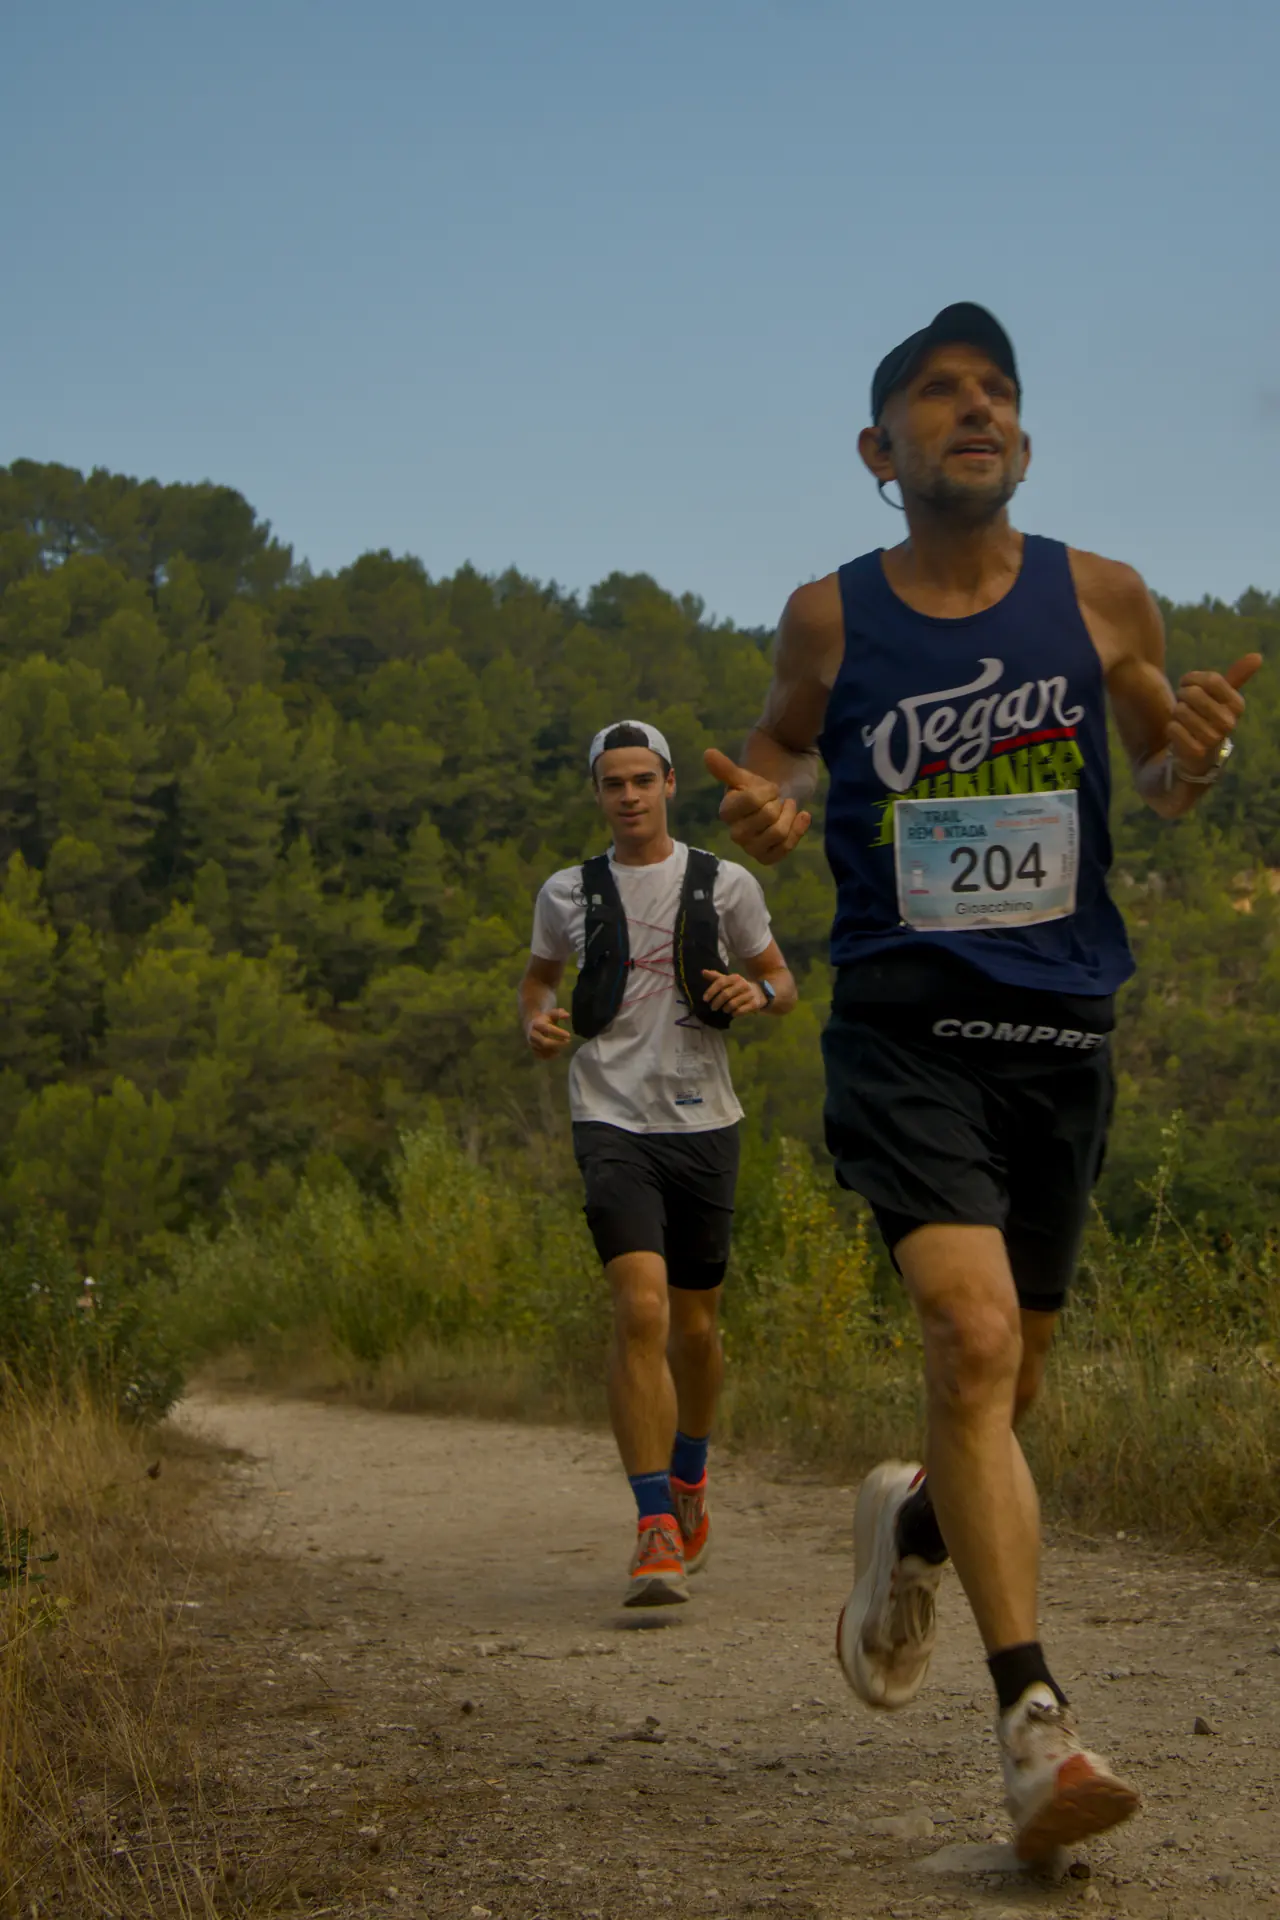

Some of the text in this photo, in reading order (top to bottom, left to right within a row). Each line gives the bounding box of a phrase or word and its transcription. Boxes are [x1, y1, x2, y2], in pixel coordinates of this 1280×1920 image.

[861, 657, 1085, 793] Vegan
[922, 809, 963, 823] TRAIL
[949, 841, 1047, 893] 204
[956, 899, 1034, 916] Gioacchino
